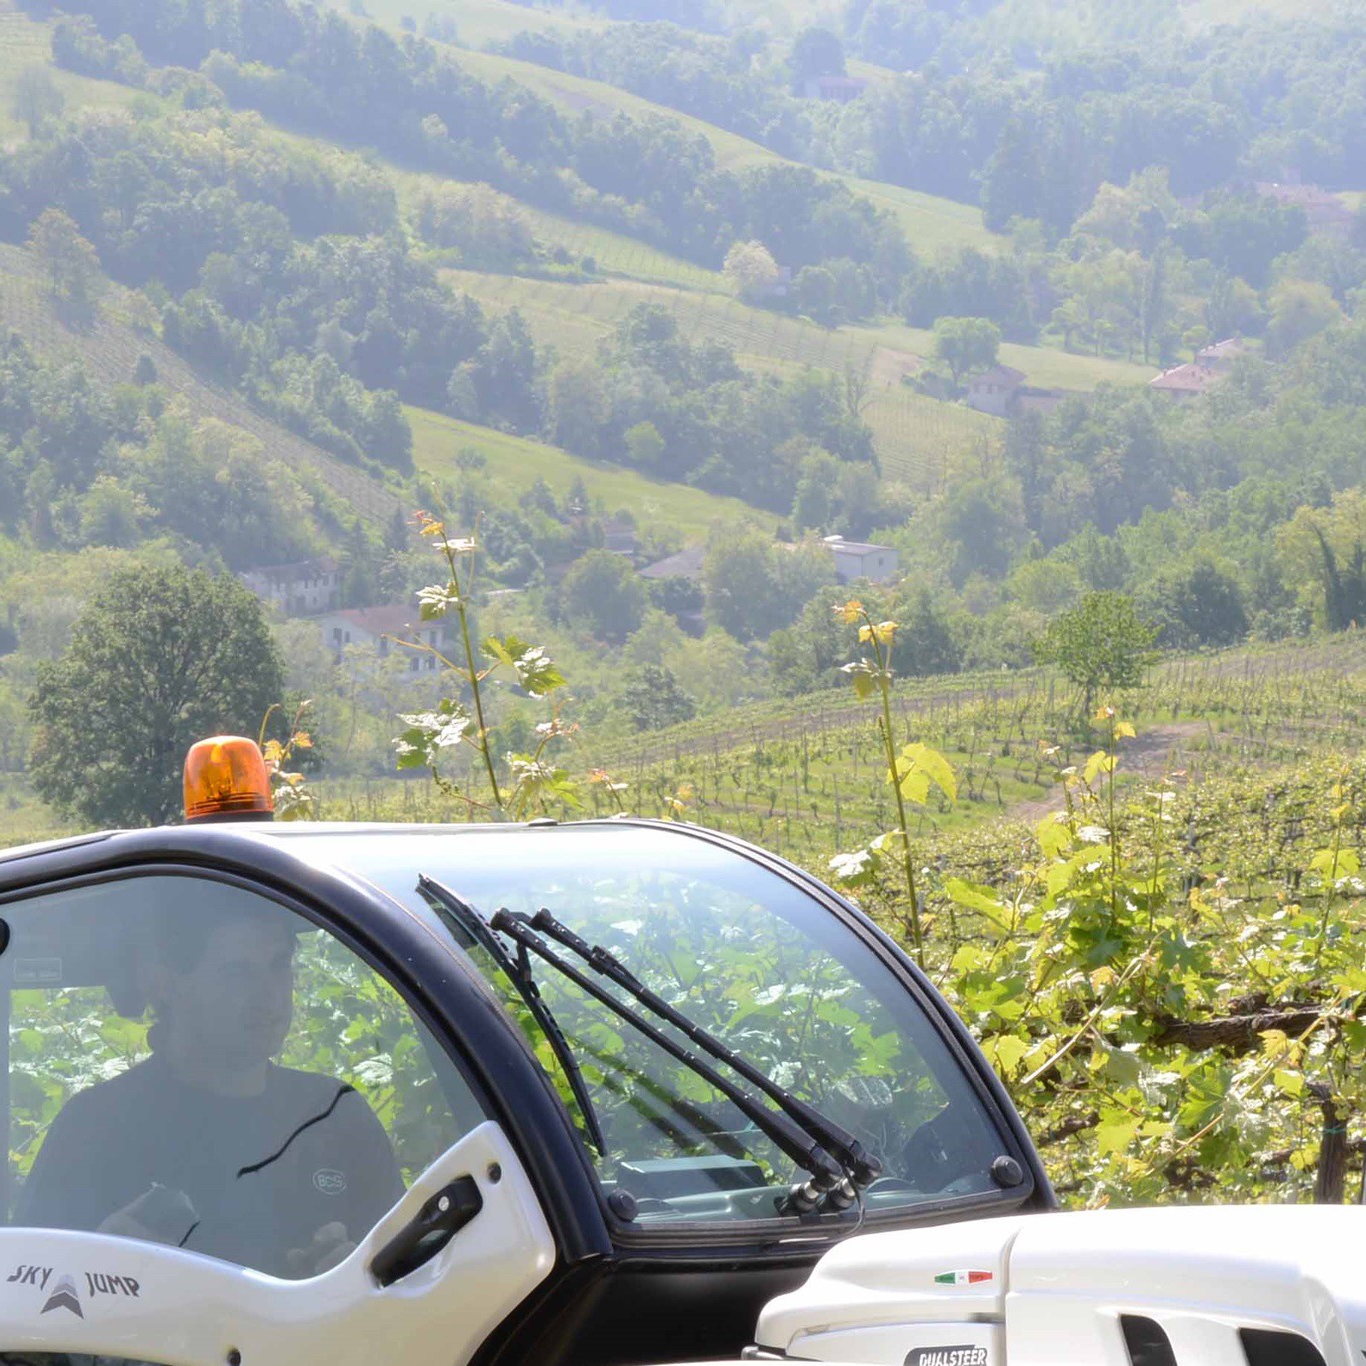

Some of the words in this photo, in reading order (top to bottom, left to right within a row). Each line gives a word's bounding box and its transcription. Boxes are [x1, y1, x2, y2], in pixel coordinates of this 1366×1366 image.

[317, 1173, 343, 1188] BCS
[6, 1264, 54, 1291] SKY
[84, 1271, 142, 1298] JUMP
